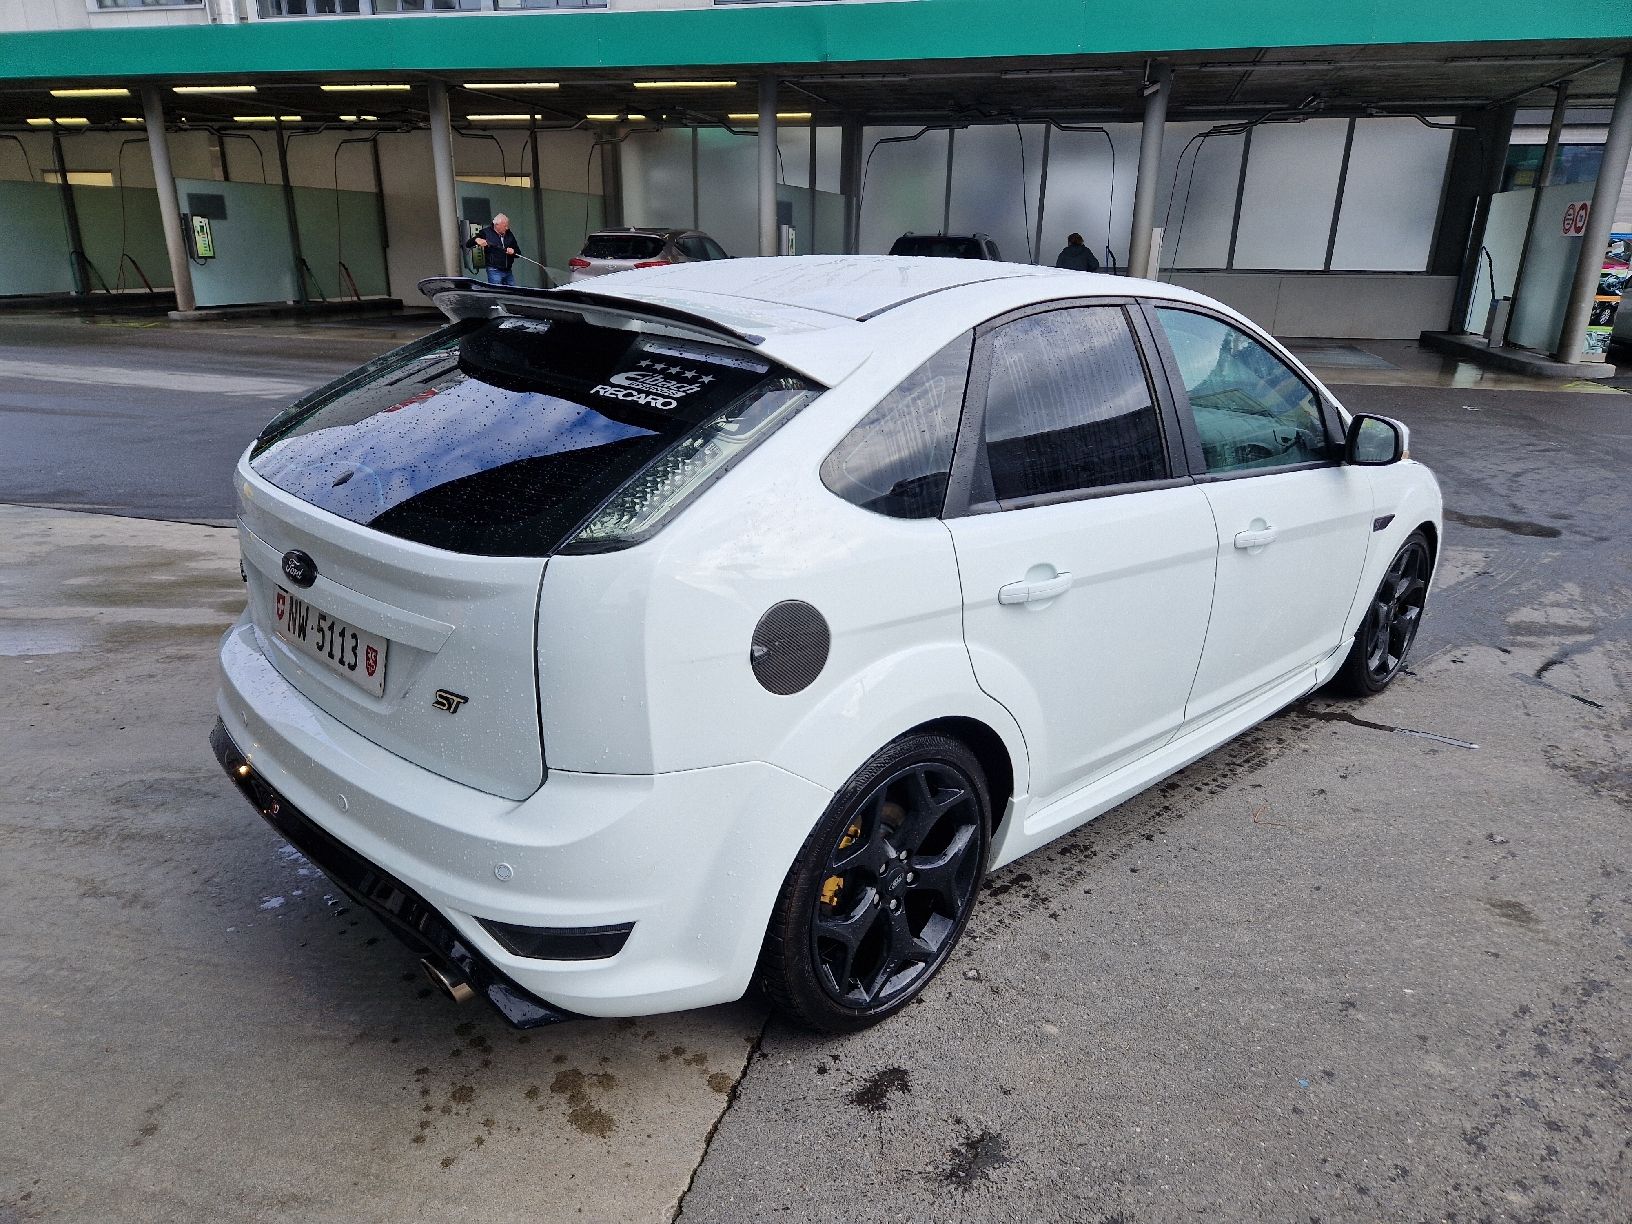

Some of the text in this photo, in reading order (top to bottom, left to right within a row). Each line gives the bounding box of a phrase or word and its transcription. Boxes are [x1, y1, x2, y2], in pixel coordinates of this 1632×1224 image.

[590, 384, 677, 409] RECARO
[285, 558, 304, 579] Ford
[432, 689, 469, 714] ST
